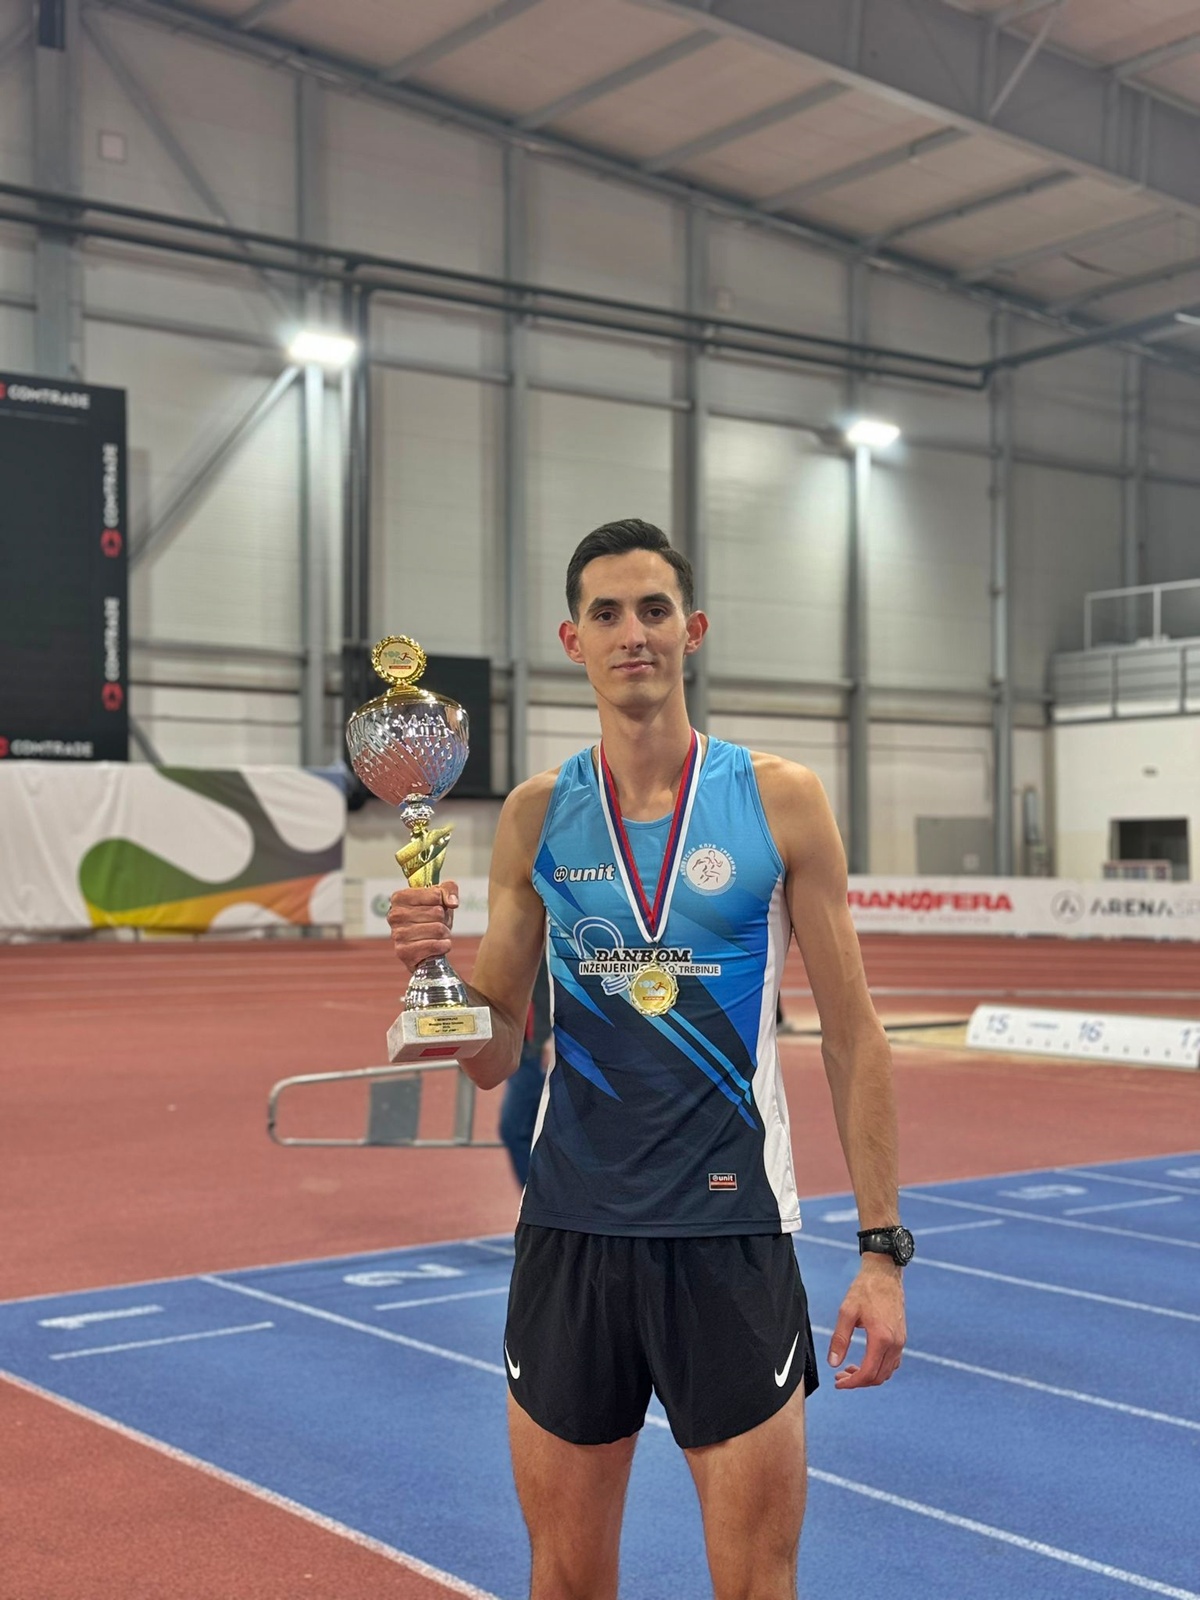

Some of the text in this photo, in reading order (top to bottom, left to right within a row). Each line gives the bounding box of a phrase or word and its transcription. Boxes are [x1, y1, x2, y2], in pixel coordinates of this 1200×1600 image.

[569, 863, 615, 881] unit
[847, 889, 1012, 911] RANSFERA
[679, 964, 720, 974] TREBINJE
